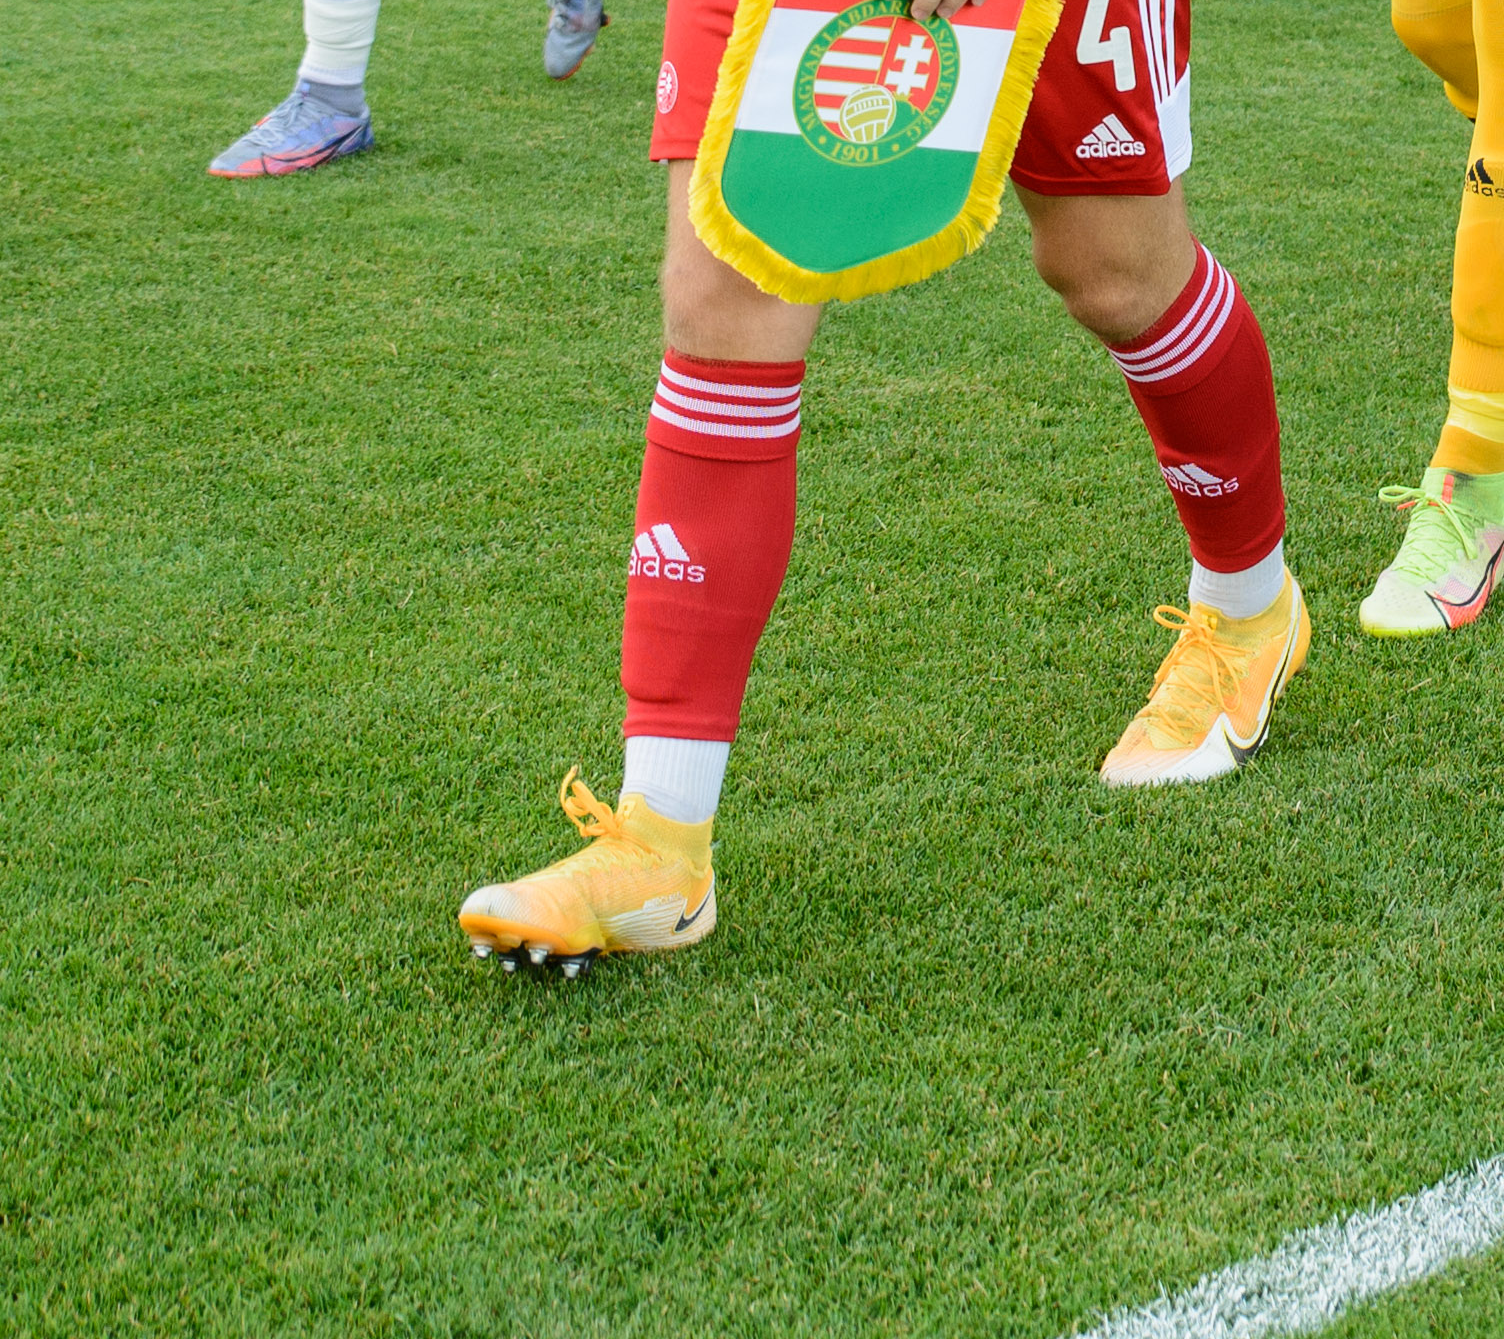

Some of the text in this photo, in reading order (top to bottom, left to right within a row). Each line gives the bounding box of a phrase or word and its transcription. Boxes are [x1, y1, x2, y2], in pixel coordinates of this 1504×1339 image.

[798, 44, 825, 132] MAGYAR
[831, 142, 880, 163] 1901
[1076, 138, 1146, 159] adidas
[628, 551, 706, 583] didas
